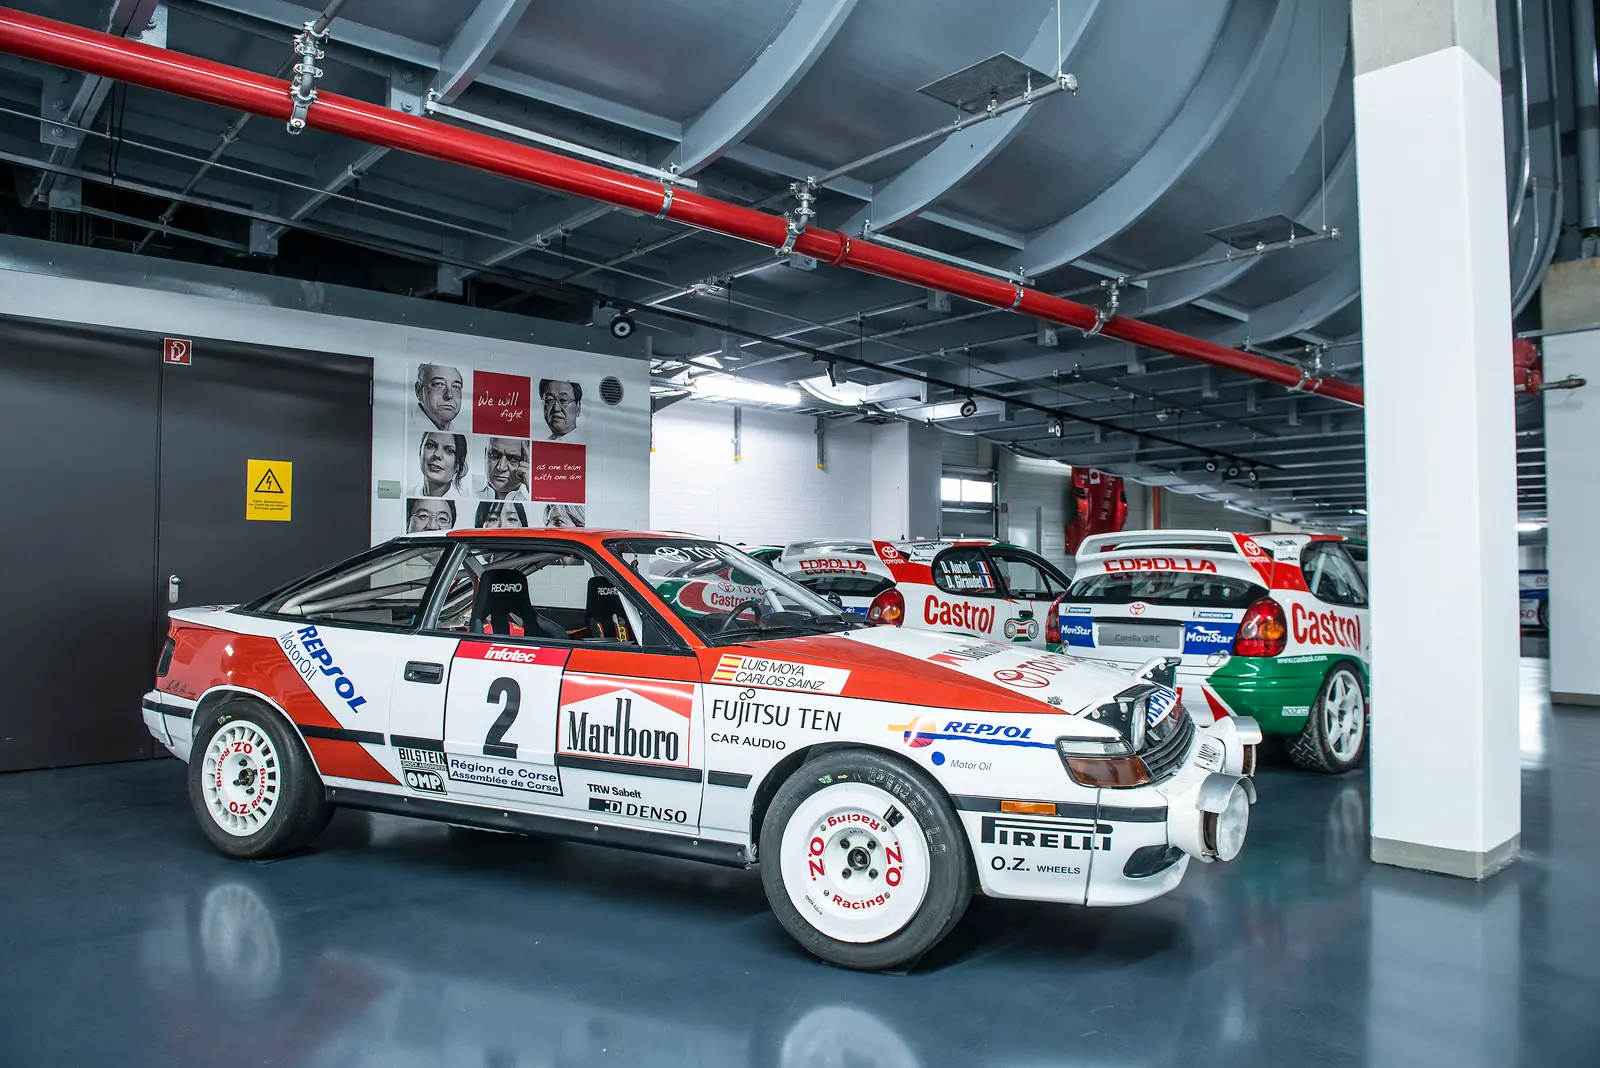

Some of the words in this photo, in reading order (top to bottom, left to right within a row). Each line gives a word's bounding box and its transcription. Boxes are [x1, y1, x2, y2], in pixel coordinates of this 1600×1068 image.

[478, 390, 494, 406] We
[498, 391, 519, 406] will
[501, 409, 523, 422] fight
[563, 463, 582, 471] team
[534, 473, 552, 481] with
[799, 558, 867, 570] COROLLA
[950, 561, 972, 574] Auriol
[1103, 558, 1217, 573] COROLLA
[491, 583, 522, 593] RECARO
[923, 594, 995, 634] Castrol
[1061, 625, 1092, 636] MoviStar
[1292, 602, 1361, 653] Castrol
[1114, 634, 1140, 643] Corolla
[1143, 634, 1161, 643] WRC
[1186, 632, 1234, 643] MoviStar
[484, 647, 536, 663] infotec
[297, 625, 367, 714] REPSOL
[741, 658, 768, 672] LUIS
[769, 660, 805, 676] MOYA
[735, 671, 784, 688] CARLOS
[786, 676, 826, 691] SAINZ
[483, 677, 521, 758] 2
[712, 698, 789, 728] FUJITSU
[799, 707, 841, 732] TEN
[567, 697, 679, 762] Marlboro
[944, 720, 1035, 740] REPSOL
[711, 732, 740, 746] CAR
[742, 736, 786, 750] AUDIO
[399, 748, 447, 765] BILSTEIN
[950, 759, 976, 770] Motor
[978, 761, 992, 771] Oil
[451, 759, 497, 776] Région
[500, 765, 514, 776] de
[518, 768, 557, 783] Corse
[406, 772, 442, 791] OMP
[451, 770, 508, 784] Assemblée
[511, 776, 524, 788] de
[525, 779, 559, 793] Corse
[587, 783, 614, 796] TRW
[615, 786, 642, 798] Sabelt
[626, 803, 687, 823] DENSO
[827, 813, 880, 831] Racing
[981, 816, 1113, 851] PIRELLI
[991, 856, 1030, 872] O.Z.
[1036, 864, 1081, 875] WHEELS
[832, 894, 885, 910] Racing
